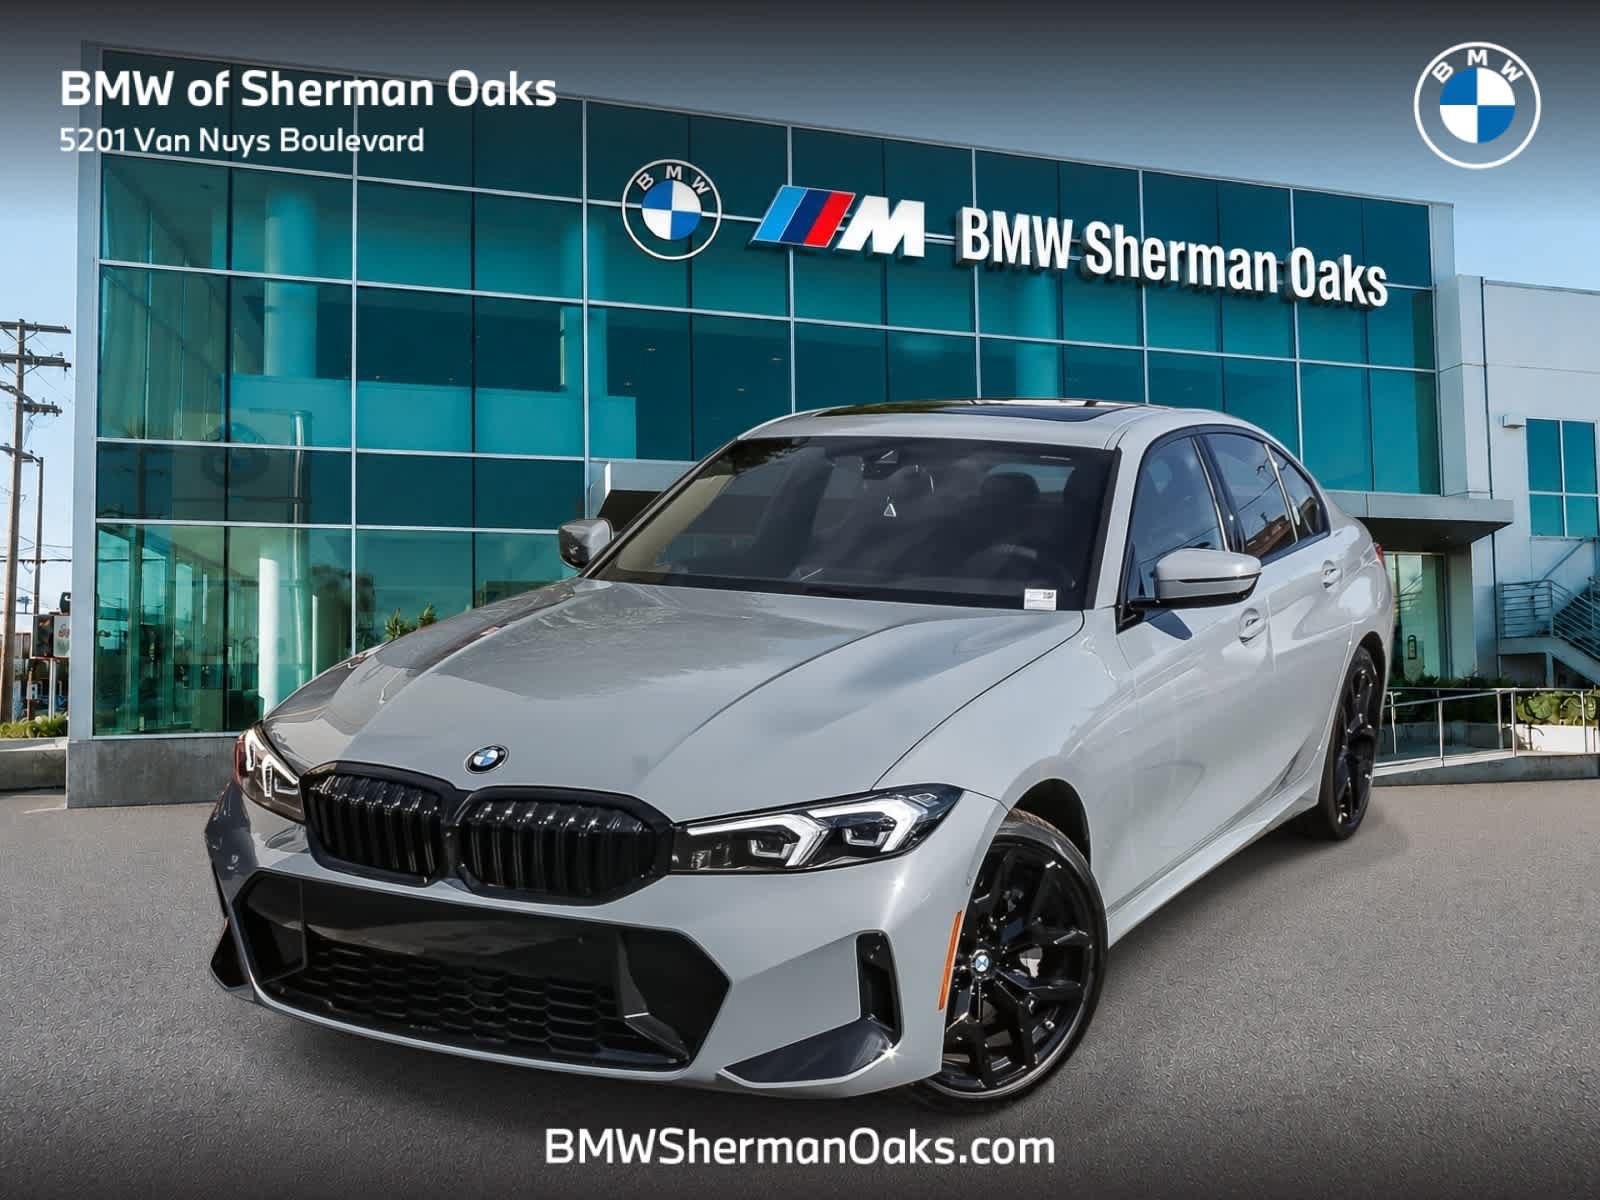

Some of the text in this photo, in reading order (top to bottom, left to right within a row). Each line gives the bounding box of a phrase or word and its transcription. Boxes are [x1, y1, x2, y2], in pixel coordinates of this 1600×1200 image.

[636, 165, 711, 195] BMW
[959, 206, 1388, 307] BMW Sherman Oaks
